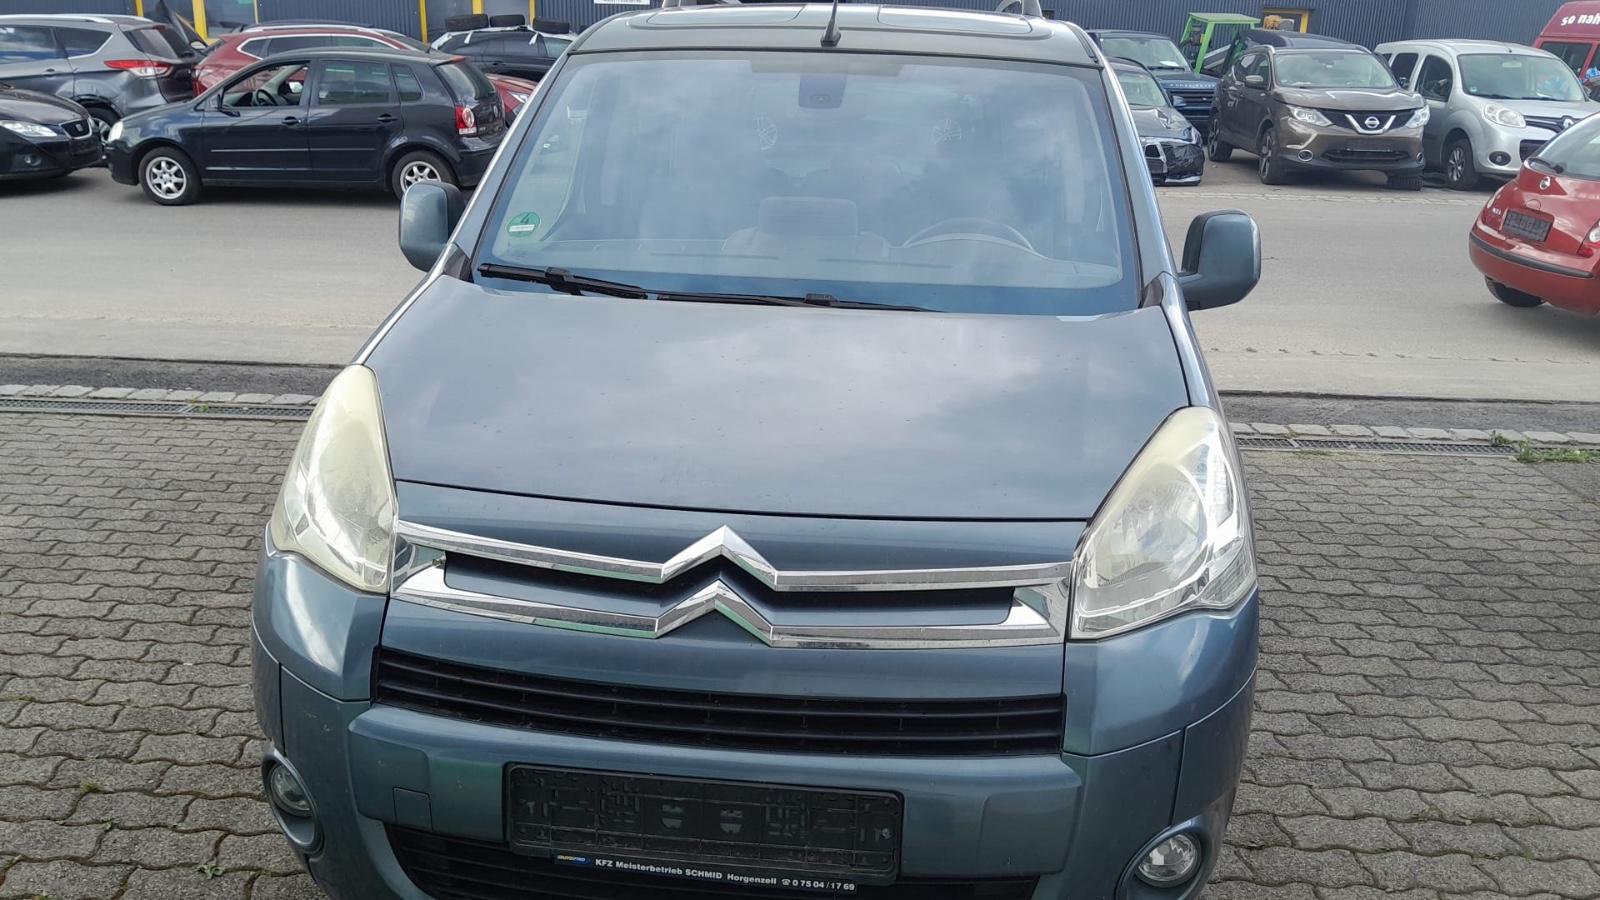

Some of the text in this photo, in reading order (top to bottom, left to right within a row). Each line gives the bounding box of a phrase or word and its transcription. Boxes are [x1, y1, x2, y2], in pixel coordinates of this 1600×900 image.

[1561, 15, 1576, 26] so
[595, 858, 613, 867] KFZ
[615, 861, 683, 875] Meisterbetrieb
[685, 868, 723, 880] SCHMID
[727, 873, 777, 885] Horgenzell
